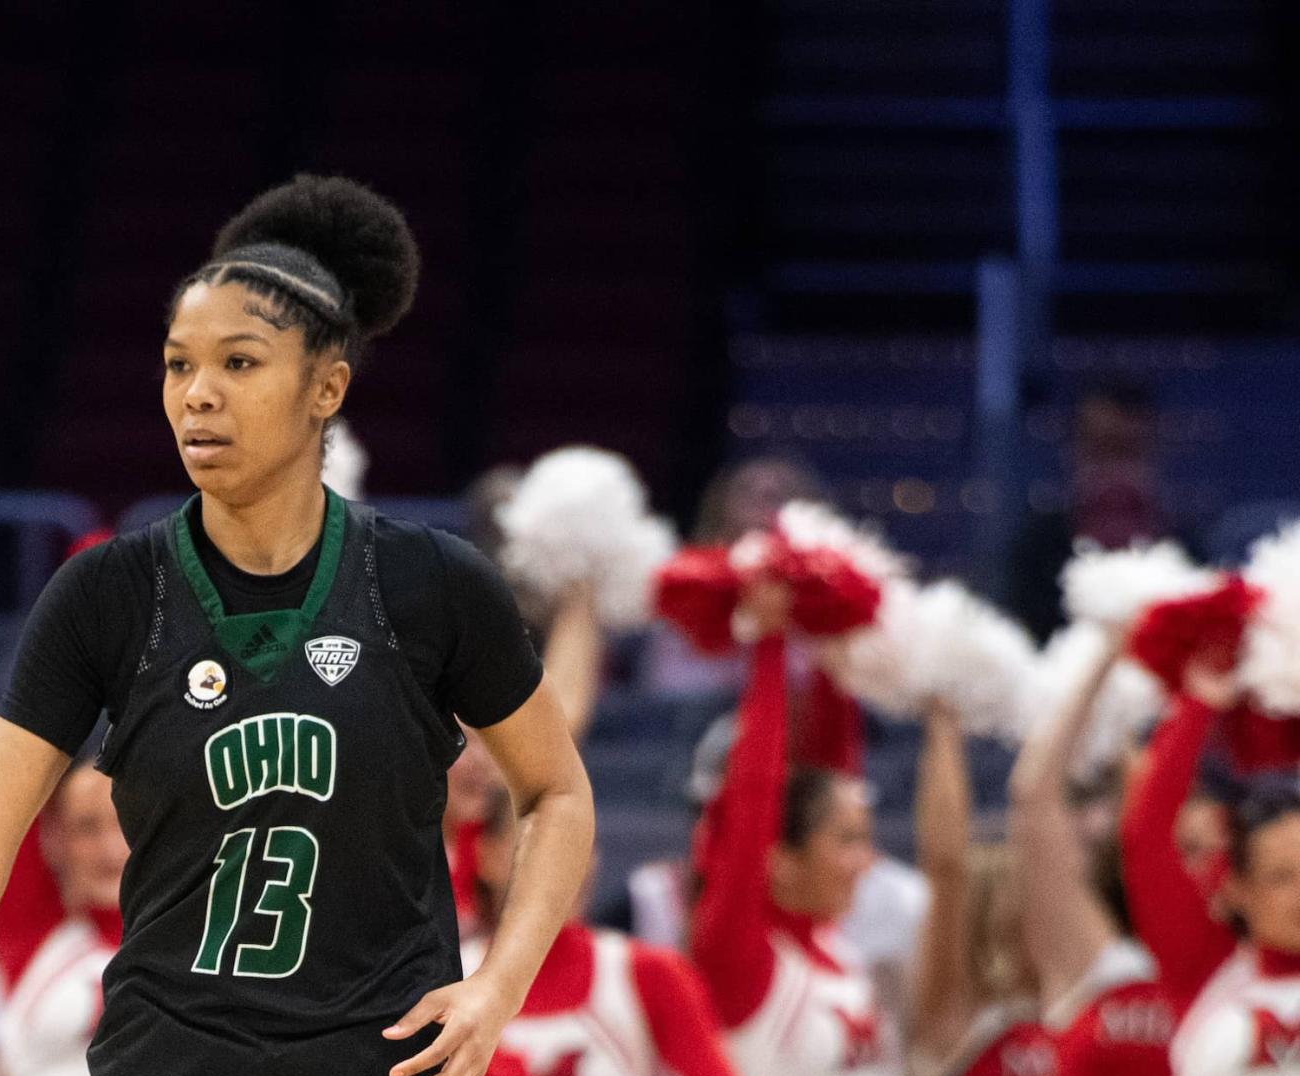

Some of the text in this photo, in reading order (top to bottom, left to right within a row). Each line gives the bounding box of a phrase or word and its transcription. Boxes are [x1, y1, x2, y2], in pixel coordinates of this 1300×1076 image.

[311, 651, 357, 664] MAC
[205, 712, 337, 810] OHIO
[191, 826, 319, 979] 13
